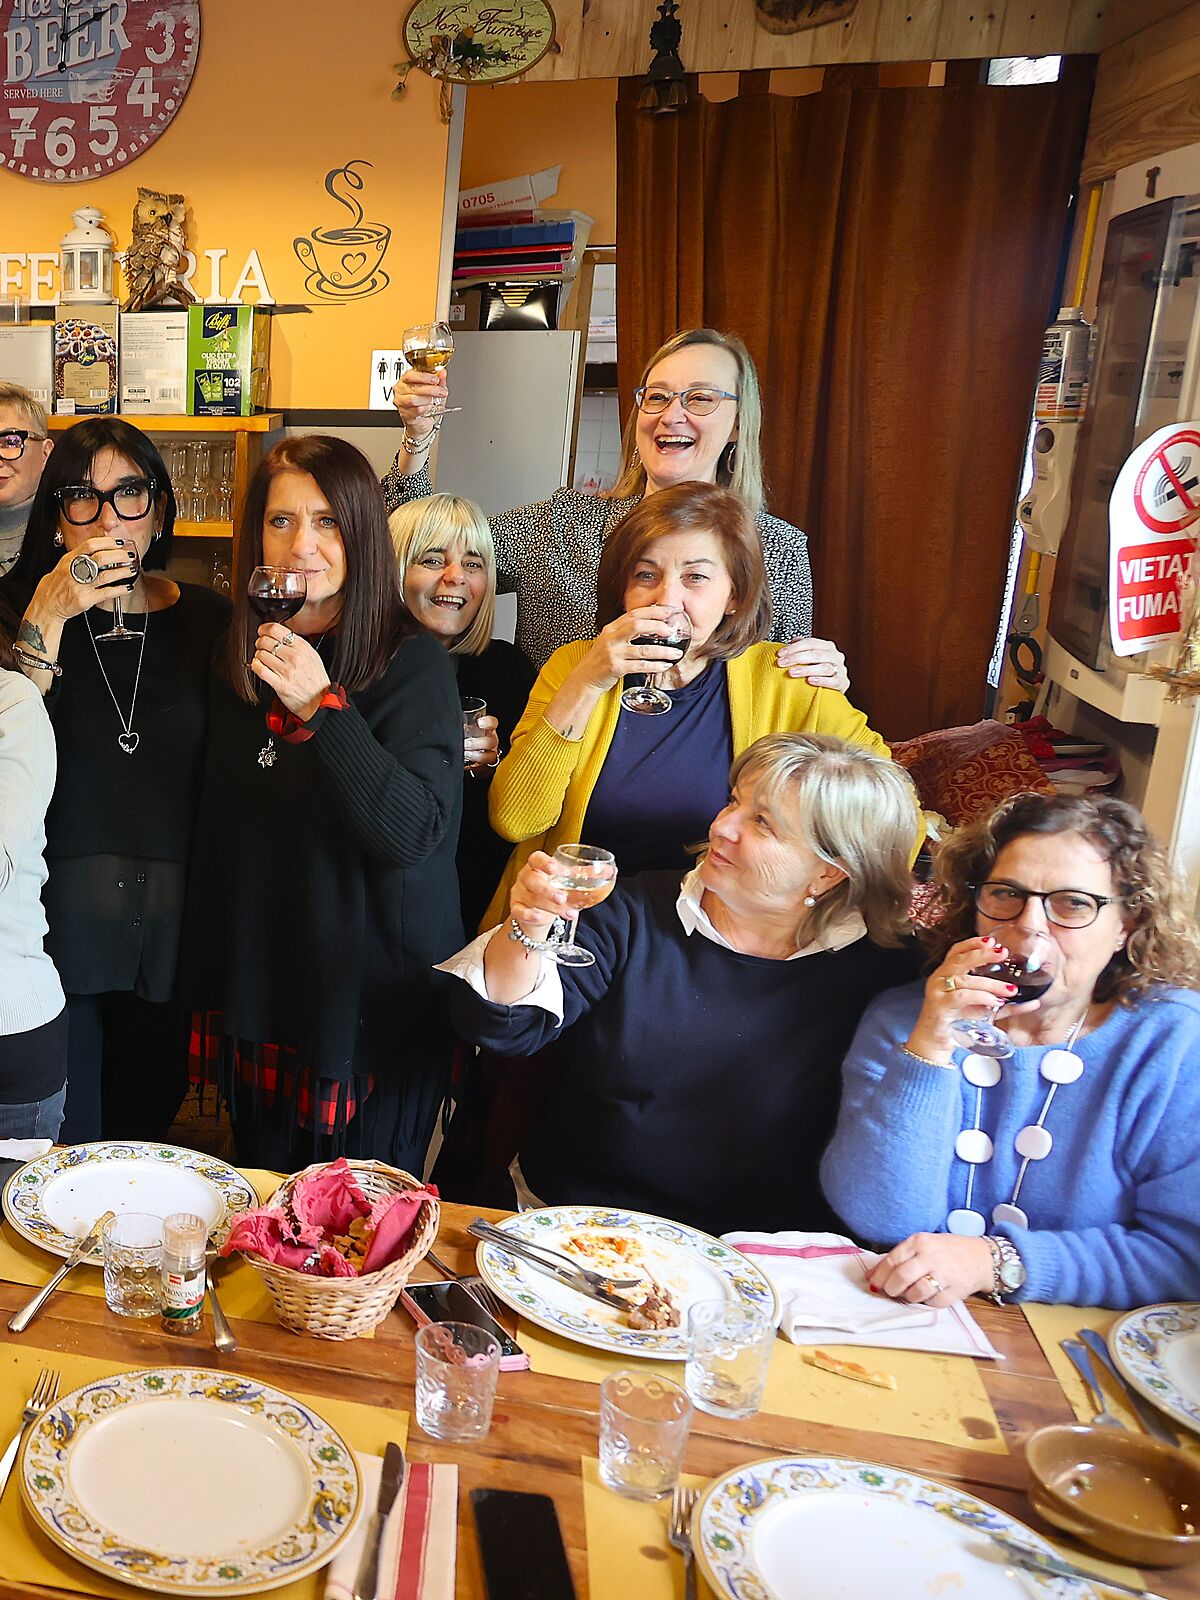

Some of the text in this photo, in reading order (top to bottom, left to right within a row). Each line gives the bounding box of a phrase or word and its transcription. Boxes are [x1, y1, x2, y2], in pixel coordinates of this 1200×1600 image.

[145, 11, 176, 64] 3
[411, 5, 469, 34] Non
[3, 0, 132, 86] BEER
[3, 87, 64, 99] SERVED HERE
[126, 66, 159, 117] 4
[8, 107, 39, 157] 7
[44, 117, 76, 167] 6
[88, 105, 119, 156] 5
[462, 193, 496, 209] 0705
[224, 377, 241, 388] 102
[1119, 552, 1195, 585] VIETAT
[1119, 591, 1183, 623] FUMA
